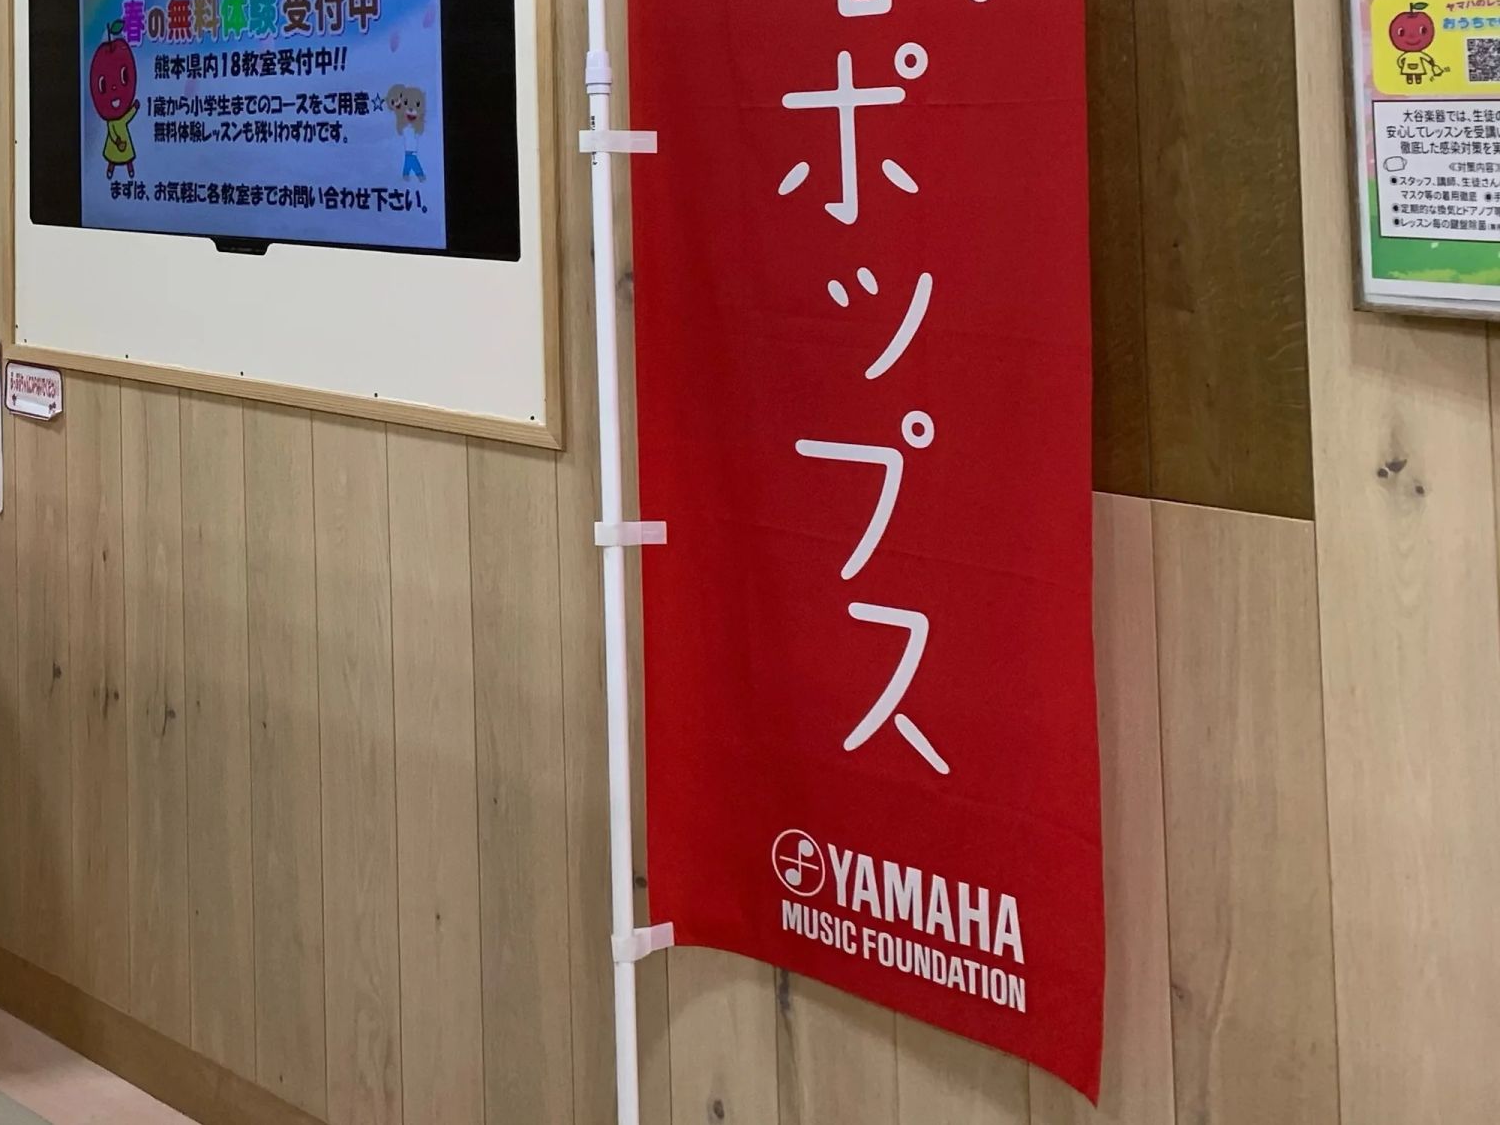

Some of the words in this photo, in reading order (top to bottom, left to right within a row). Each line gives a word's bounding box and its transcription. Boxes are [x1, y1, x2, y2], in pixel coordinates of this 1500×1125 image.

[1443, 16, 1500, 29] おうちで
[153, 121, 349, 144] 無料体験レッスンも残りわずかです。
[110, 180, 429, 214] まずは、お気軽に各教室までお問い合わせ下さい。
[827, 842, 1025, 965] YAMAHA
[781, 899, 858, 955] MUSIC
[862, 927, 1026, 1014] FOUNDATION
